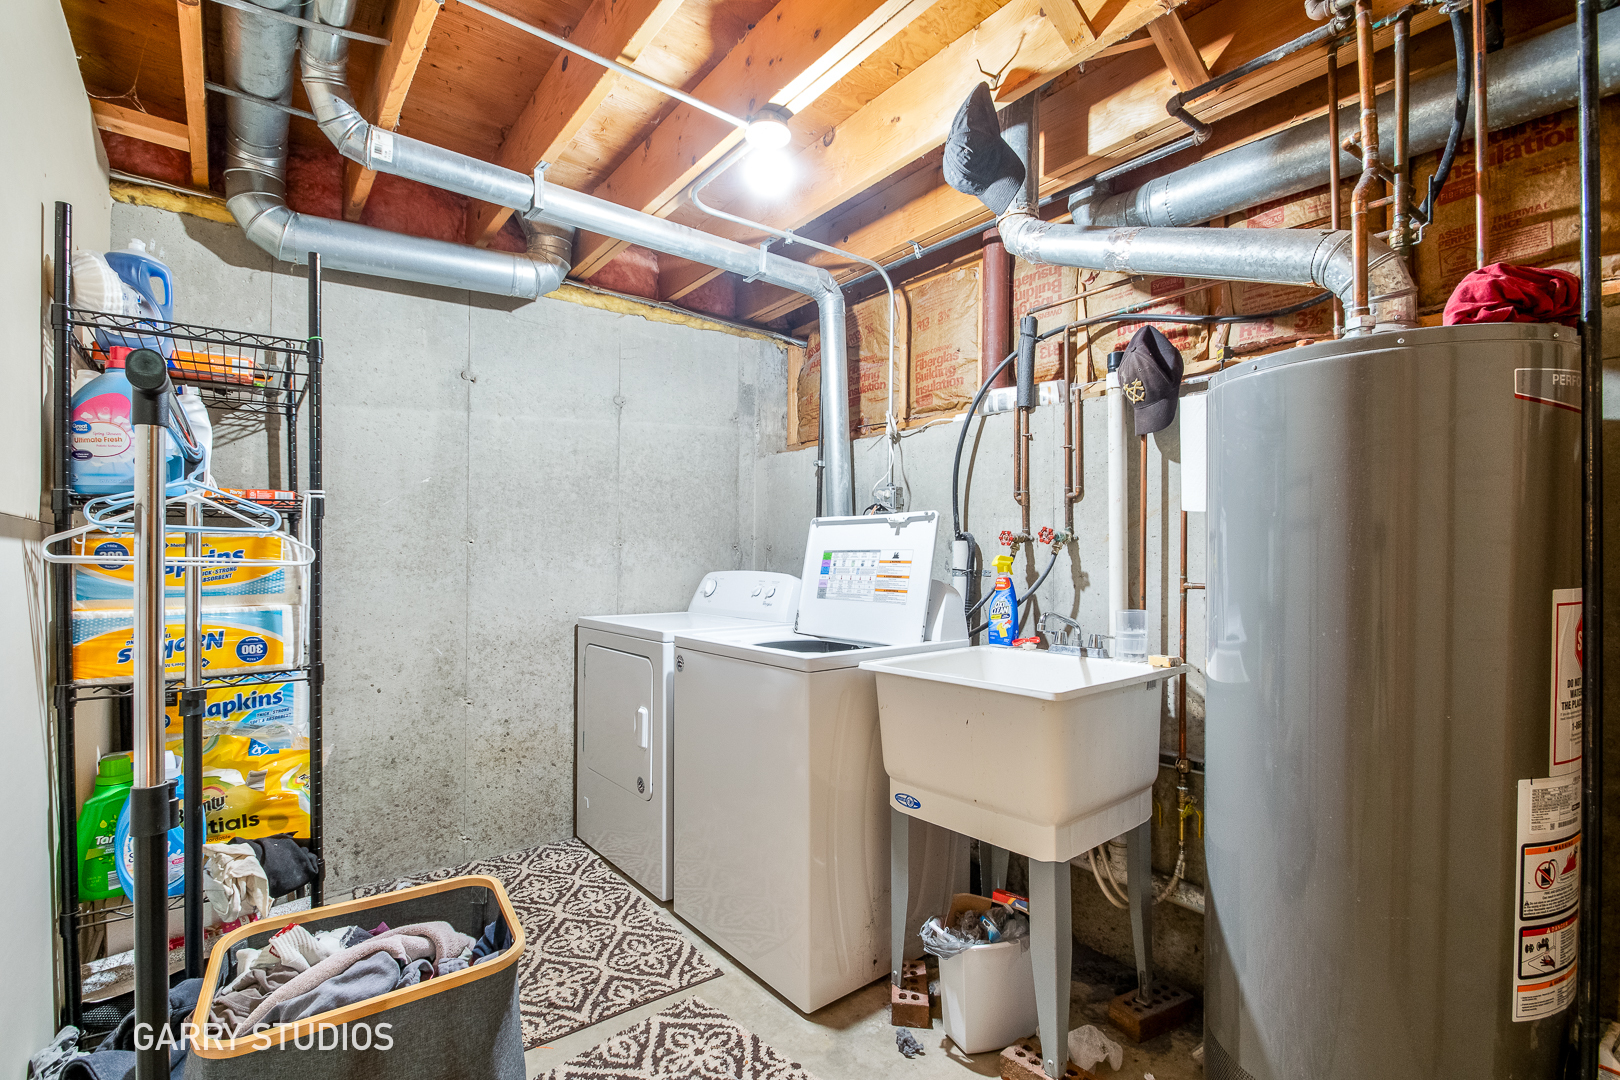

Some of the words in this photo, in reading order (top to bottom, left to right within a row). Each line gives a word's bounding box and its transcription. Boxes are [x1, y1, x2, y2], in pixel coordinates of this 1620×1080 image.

[915, 350, 960, 372] Fiberglas
[915, 364, 957, 384] Building
[915, 376, 965, 396] Insulation
[202, 573, 233, 583] BSORBENT
[991, 606, 1010, 615] CLEAN
[241, 644, 264, 655] 300
[202, 690, 284, 719] apkins
